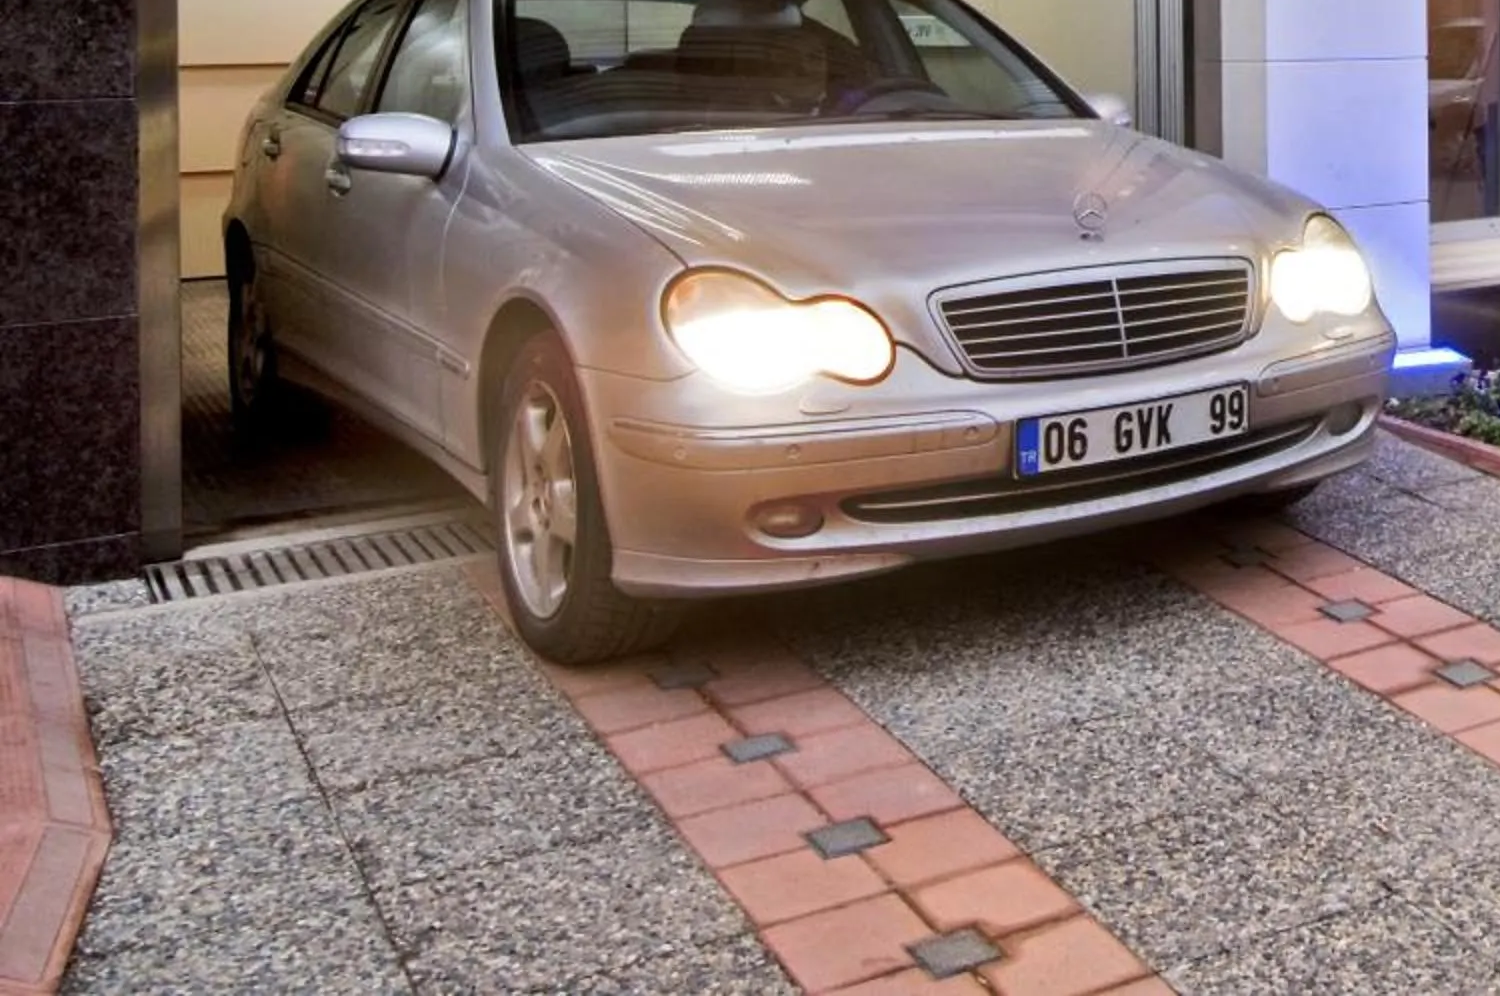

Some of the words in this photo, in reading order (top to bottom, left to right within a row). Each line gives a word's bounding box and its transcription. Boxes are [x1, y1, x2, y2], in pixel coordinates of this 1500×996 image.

[1044, 417, 1088, 465] 06
[1114, 403, 1174, 454] GVK
[1209, 389, 1245, 435] 99
